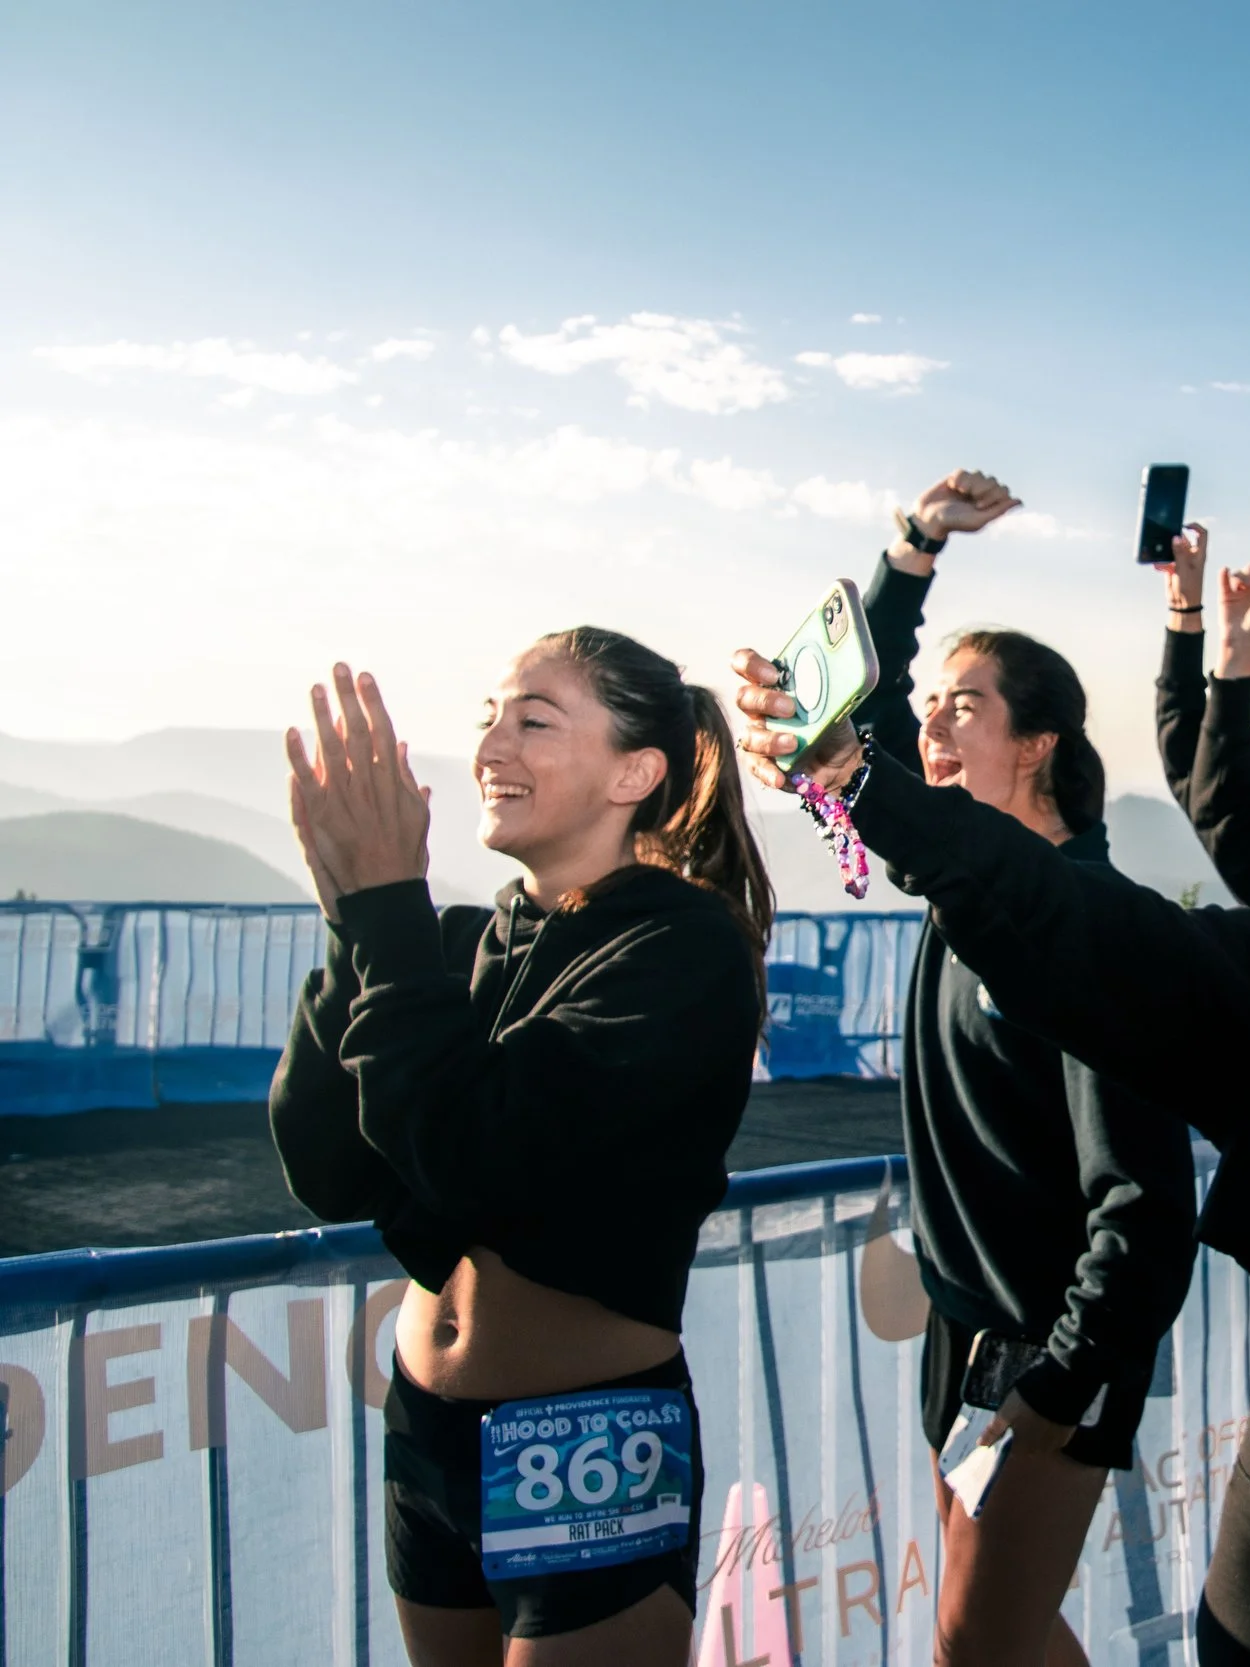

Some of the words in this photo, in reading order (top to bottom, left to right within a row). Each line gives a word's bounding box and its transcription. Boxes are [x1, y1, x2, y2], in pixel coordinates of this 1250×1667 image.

[501, 1417, 571, 1443] HOOD
[577, 1413, 608, 1434] TO
[616, 1402, 681, 1429] COAST
[554, 1398, 610, 1413] PROVIDENCE
[515, 1430, 663, 1511] 869
[569, 1522, 591, 1542] RAT
[594, 1518, 625, 1539] PACK
[696, 1479, 887, 1592] Michelob
